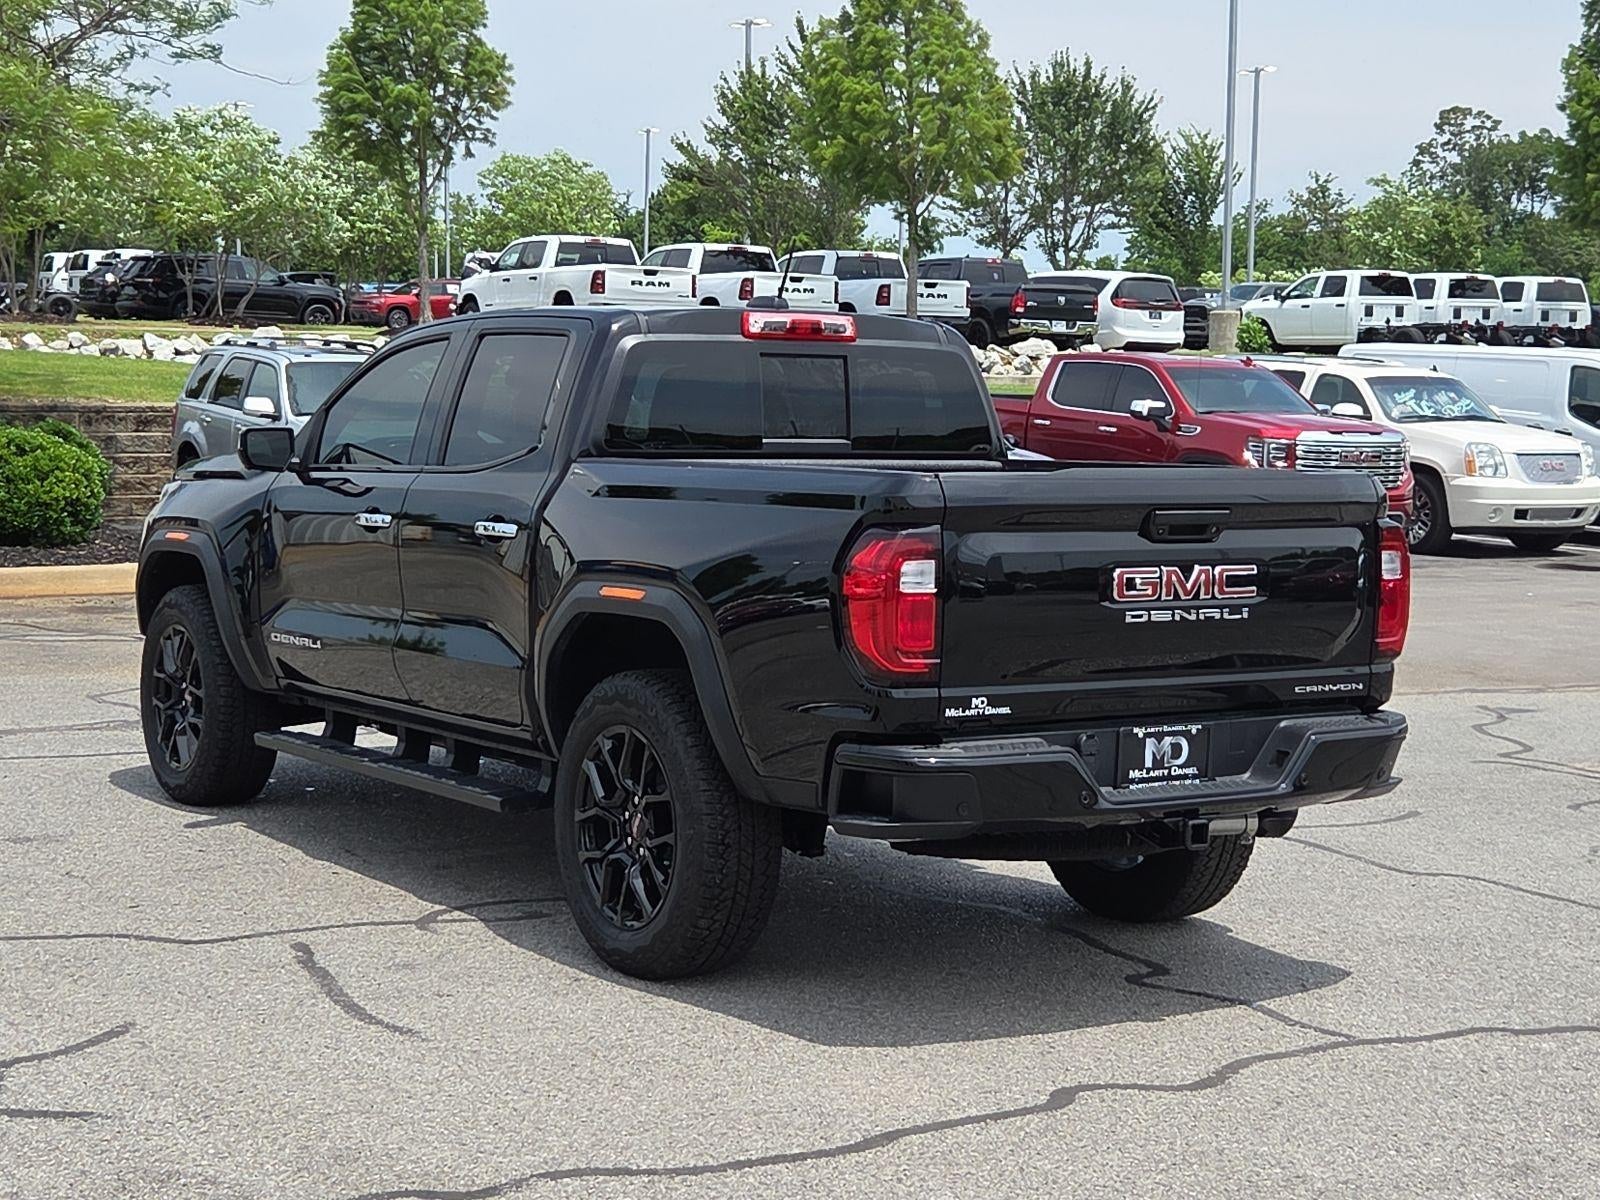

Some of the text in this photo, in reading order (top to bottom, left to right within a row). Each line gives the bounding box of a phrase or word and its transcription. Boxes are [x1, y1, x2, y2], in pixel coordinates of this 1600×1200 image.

[630, 280, 671, 288] RAM
[1112, 564, 1258, 601] GMC
[1124, 607, 1249, 624] DENALI
[270, 632, 322, 649] DENALI
[1294, 682, 1363, 693] CANYON
